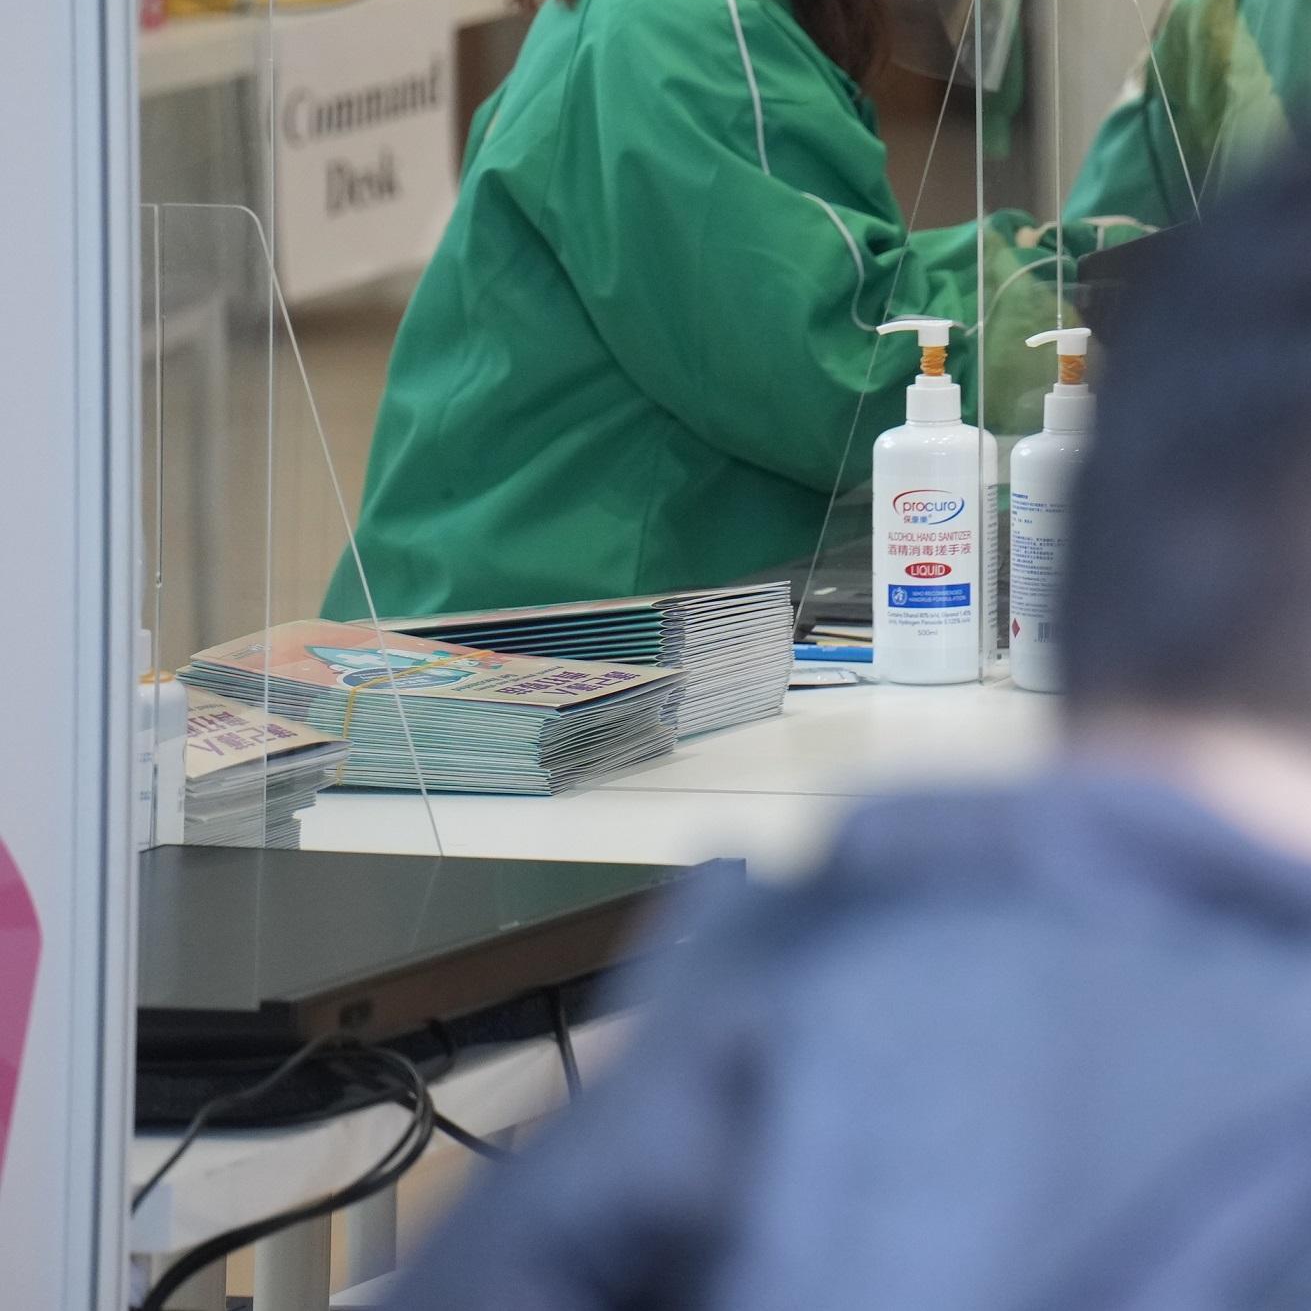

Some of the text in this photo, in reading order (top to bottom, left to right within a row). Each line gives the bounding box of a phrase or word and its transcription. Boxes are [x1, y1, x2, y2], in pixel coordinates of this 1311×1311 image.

[902, 500, 957, 514] procuro
[888, 530, 971, 542] ALCOHOL HAND SANITIZER
[910, 564, 946, 576] LIQUID
